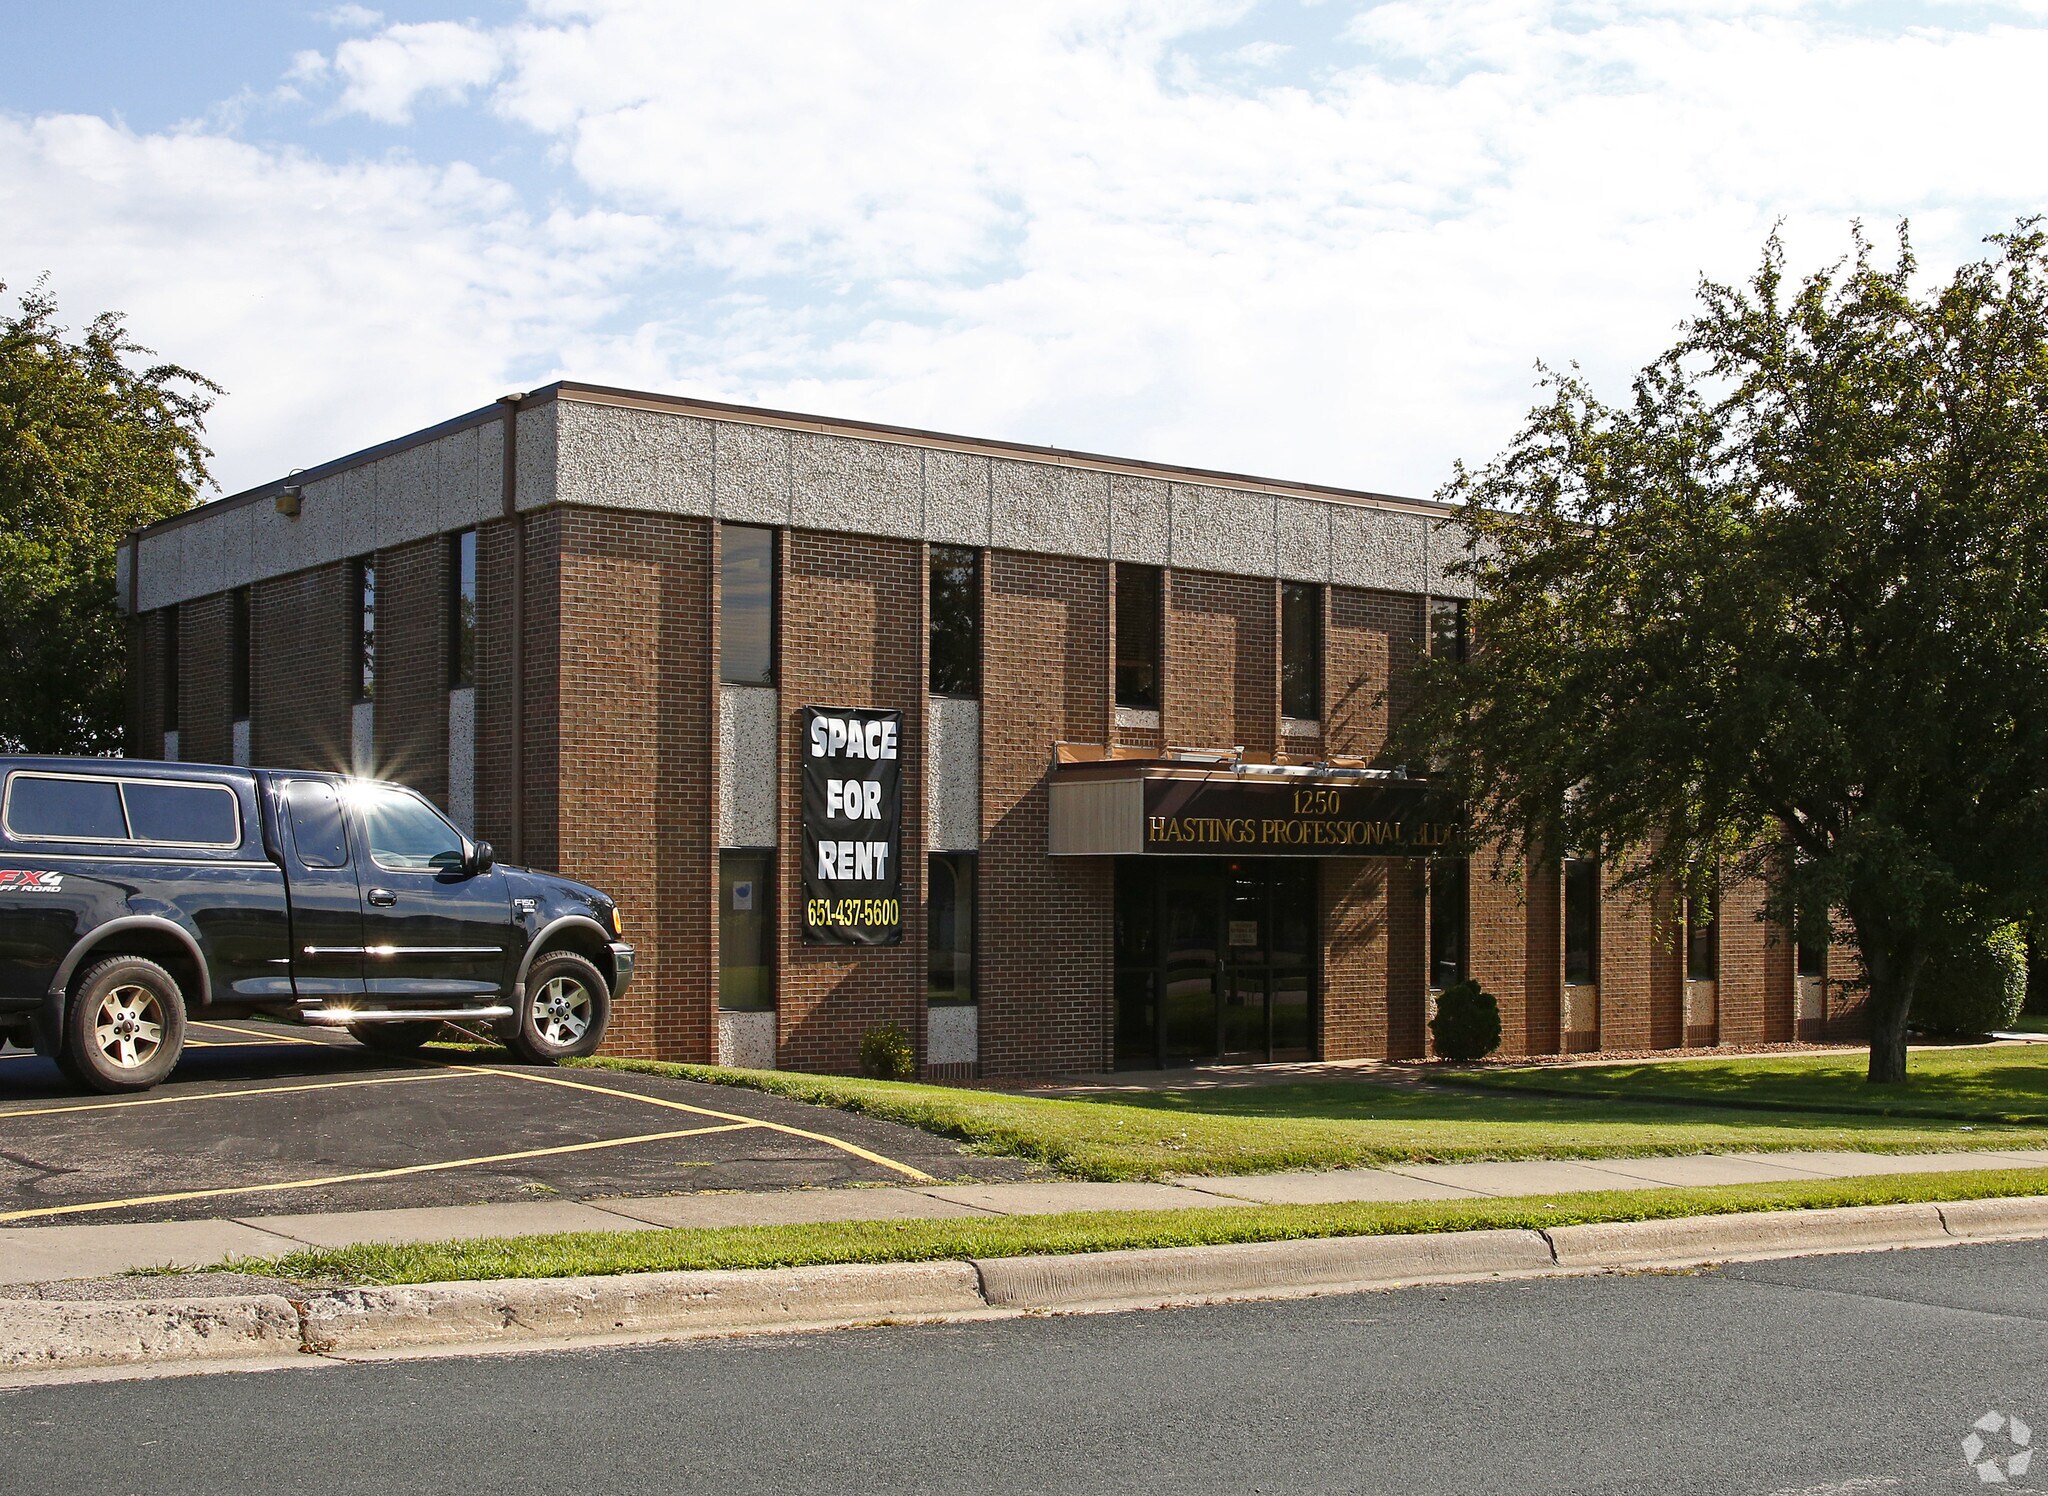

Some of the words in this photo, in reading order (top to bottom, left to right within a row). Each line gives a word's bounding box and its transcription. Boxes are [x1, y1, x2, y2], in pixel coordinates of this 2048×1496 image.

[810, 715, 897, 760] SPACE
[826, 779, 882, 820] FOR
[1293, 790, 1340, 815] 1250
[1148, 816, 1256, 843] HASTINGS
[1261, 819, 1407, 846] PROFESSIONAL
[817, 840, 889, 881] RENT
[0, 869, 65, 886] FX4
[0, 884, 19, 892] FF
[20, 885, 62, 893] ROAD
[807, 898, 899, 927] 651-437-5600
